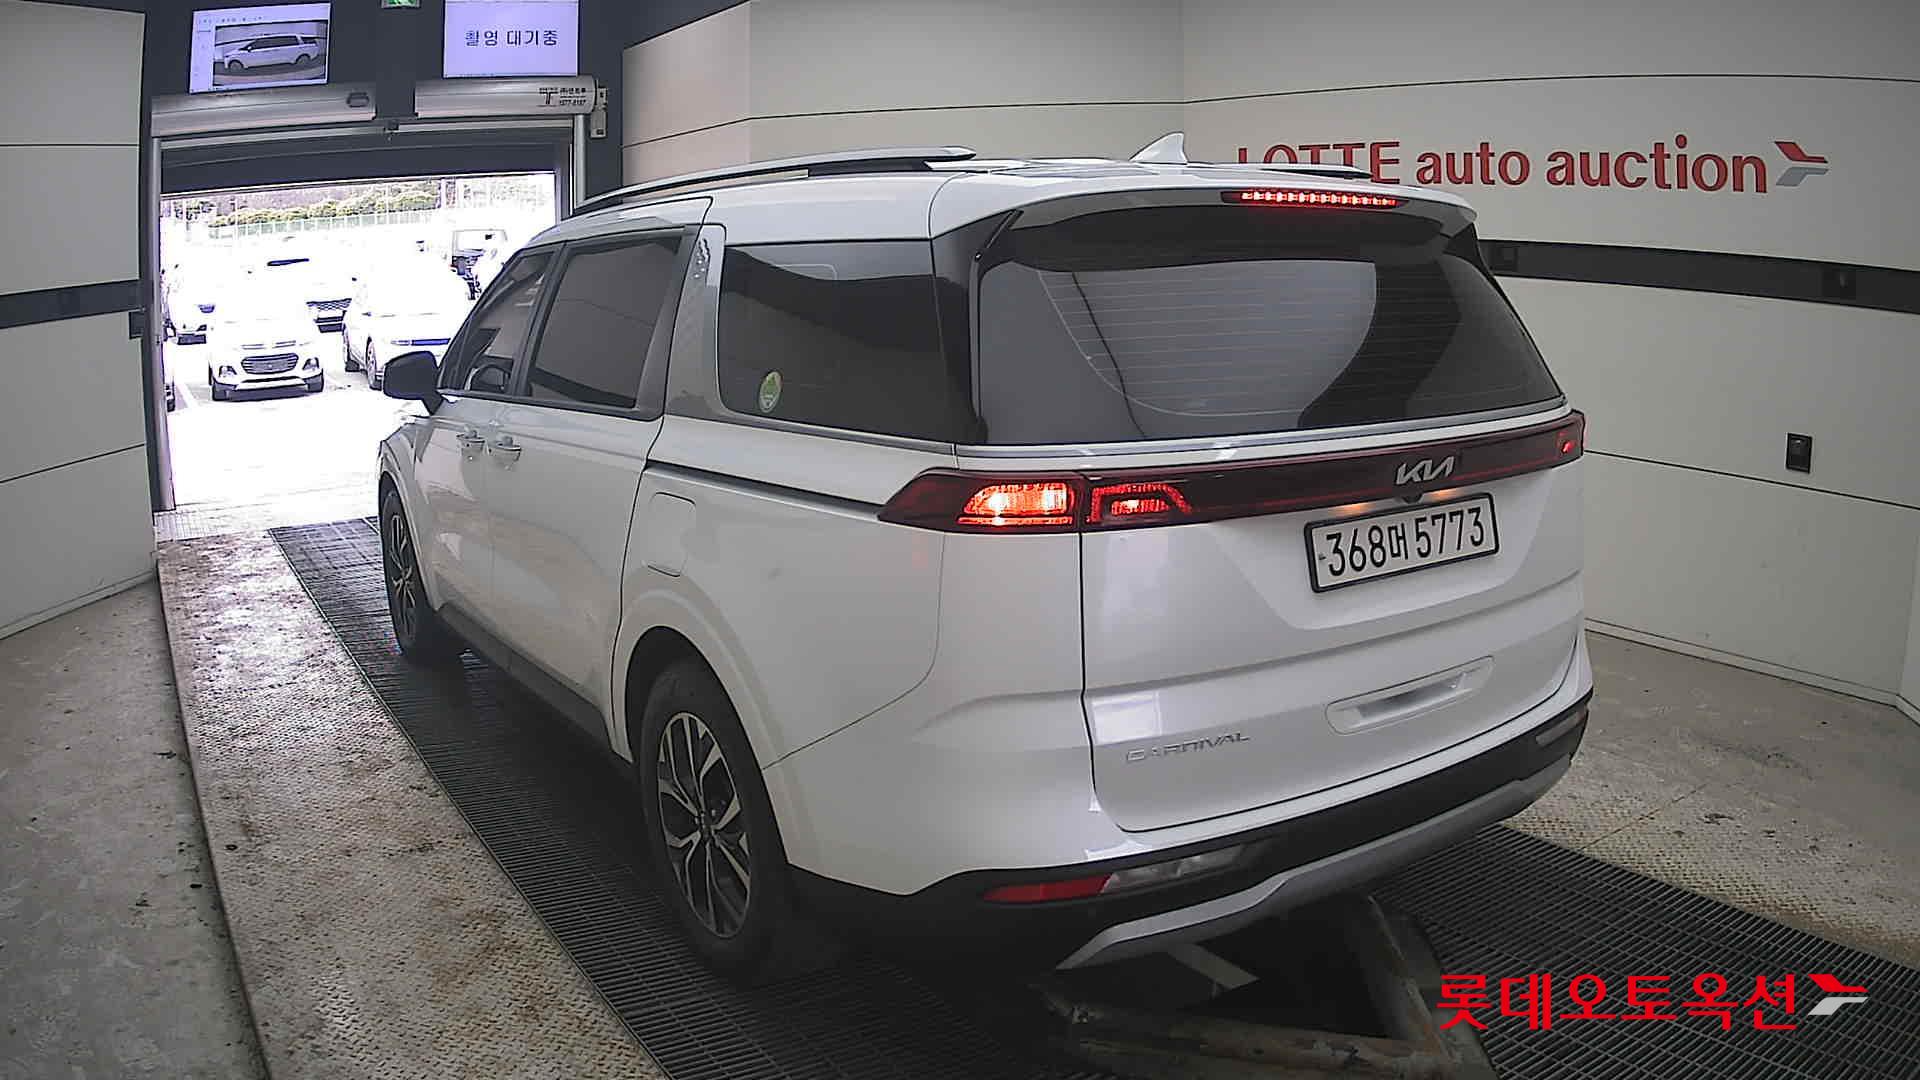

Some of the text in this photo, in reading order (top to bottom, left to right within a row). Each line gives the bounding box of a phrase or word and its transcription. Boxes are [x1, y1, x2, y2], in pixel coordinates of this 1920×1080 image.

[506, 29, 559, 46] 대기중
[1416, 142, 1530, 185] auto
[1546, 134, 1767, 193] auction
[1414, 506, 1485, 558] 5773
